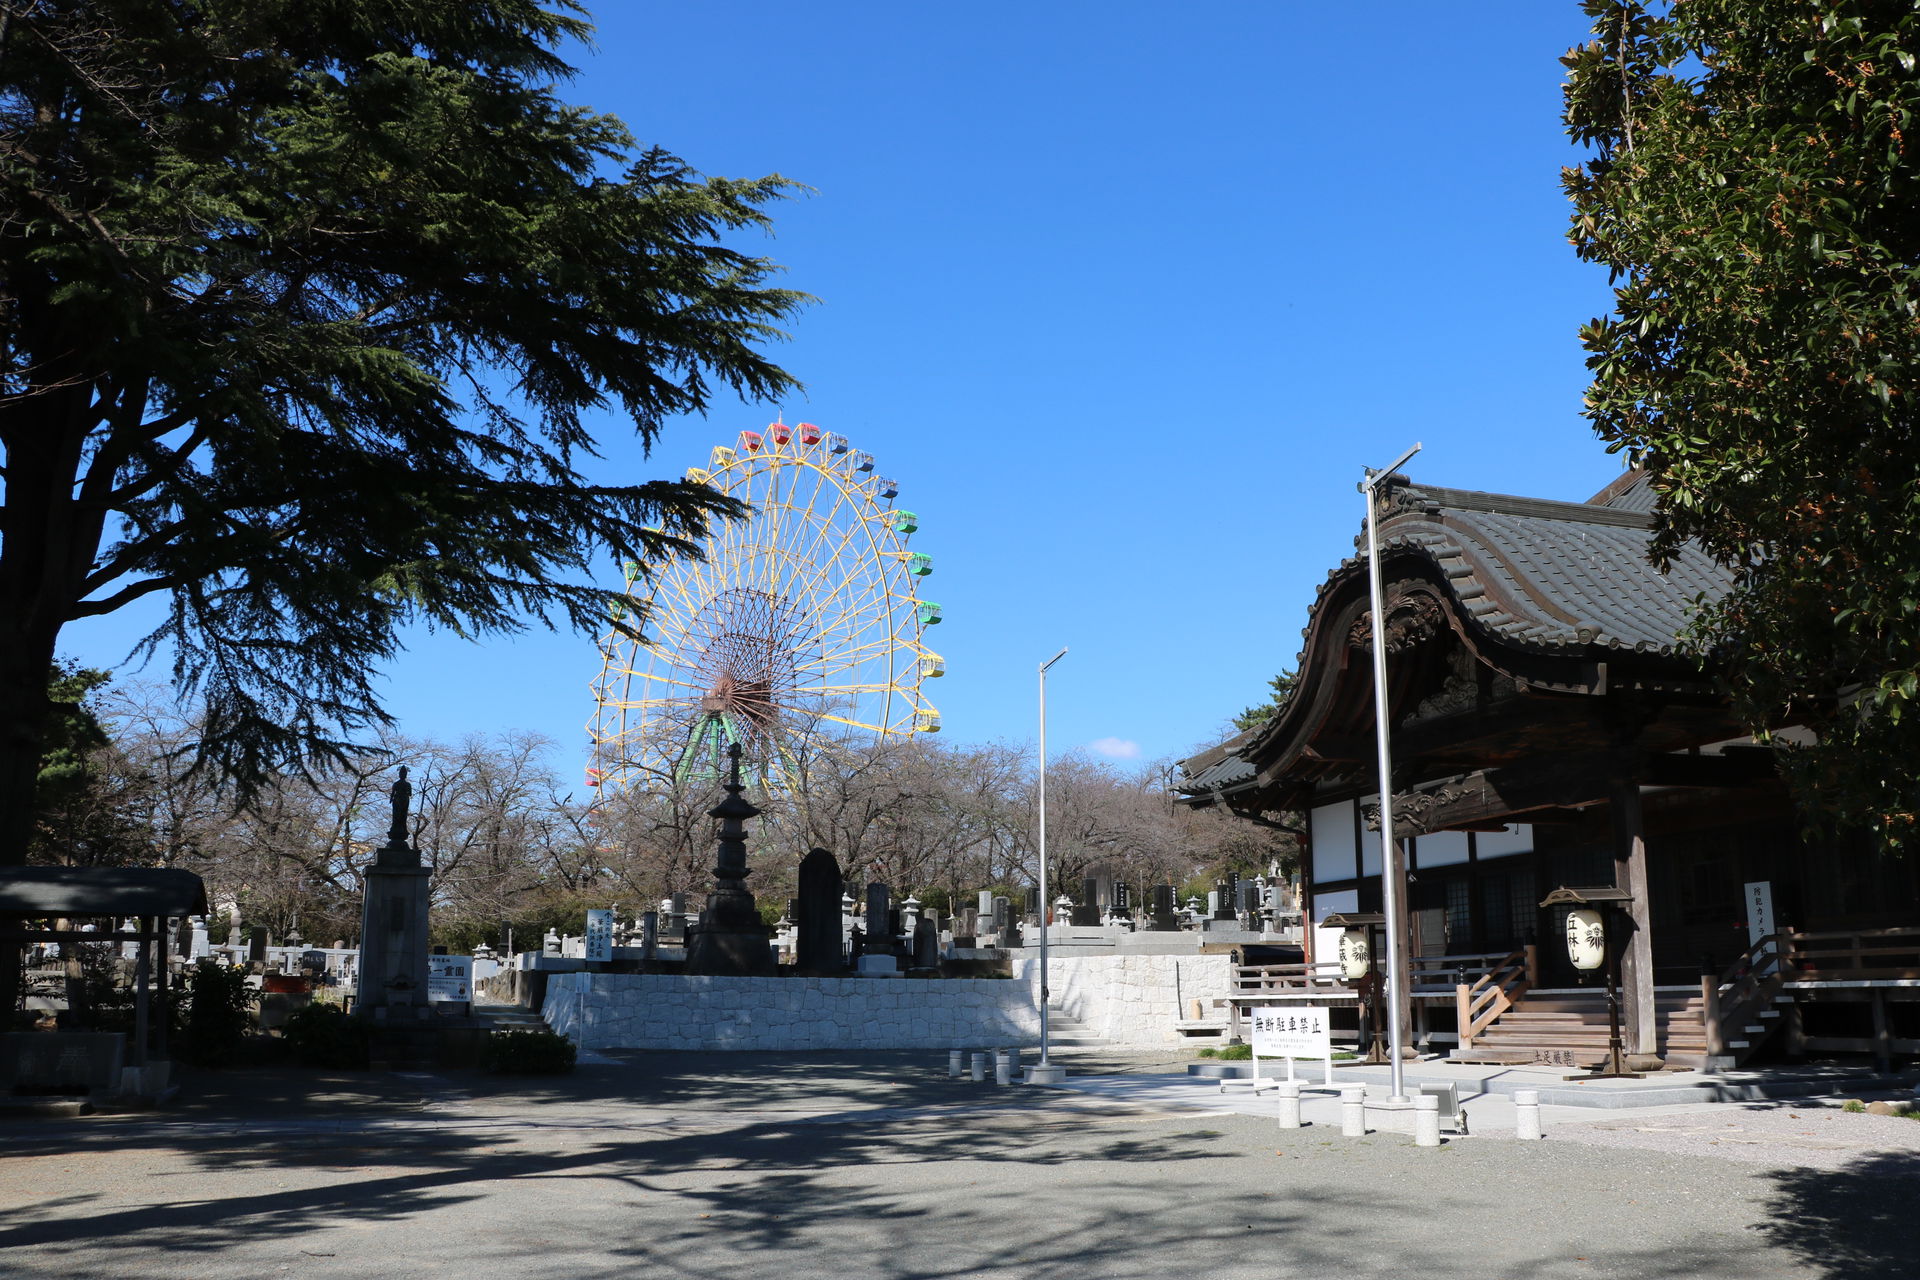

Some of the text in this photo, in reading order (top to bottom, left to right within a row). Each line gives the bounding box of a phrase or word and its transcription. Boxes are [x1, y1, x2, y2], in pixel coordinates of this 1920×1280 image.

[1255, 1016, 1321, 1034] 無断駐車禁止
[1533, 1050, 1572, 1066] 土足厳禁
